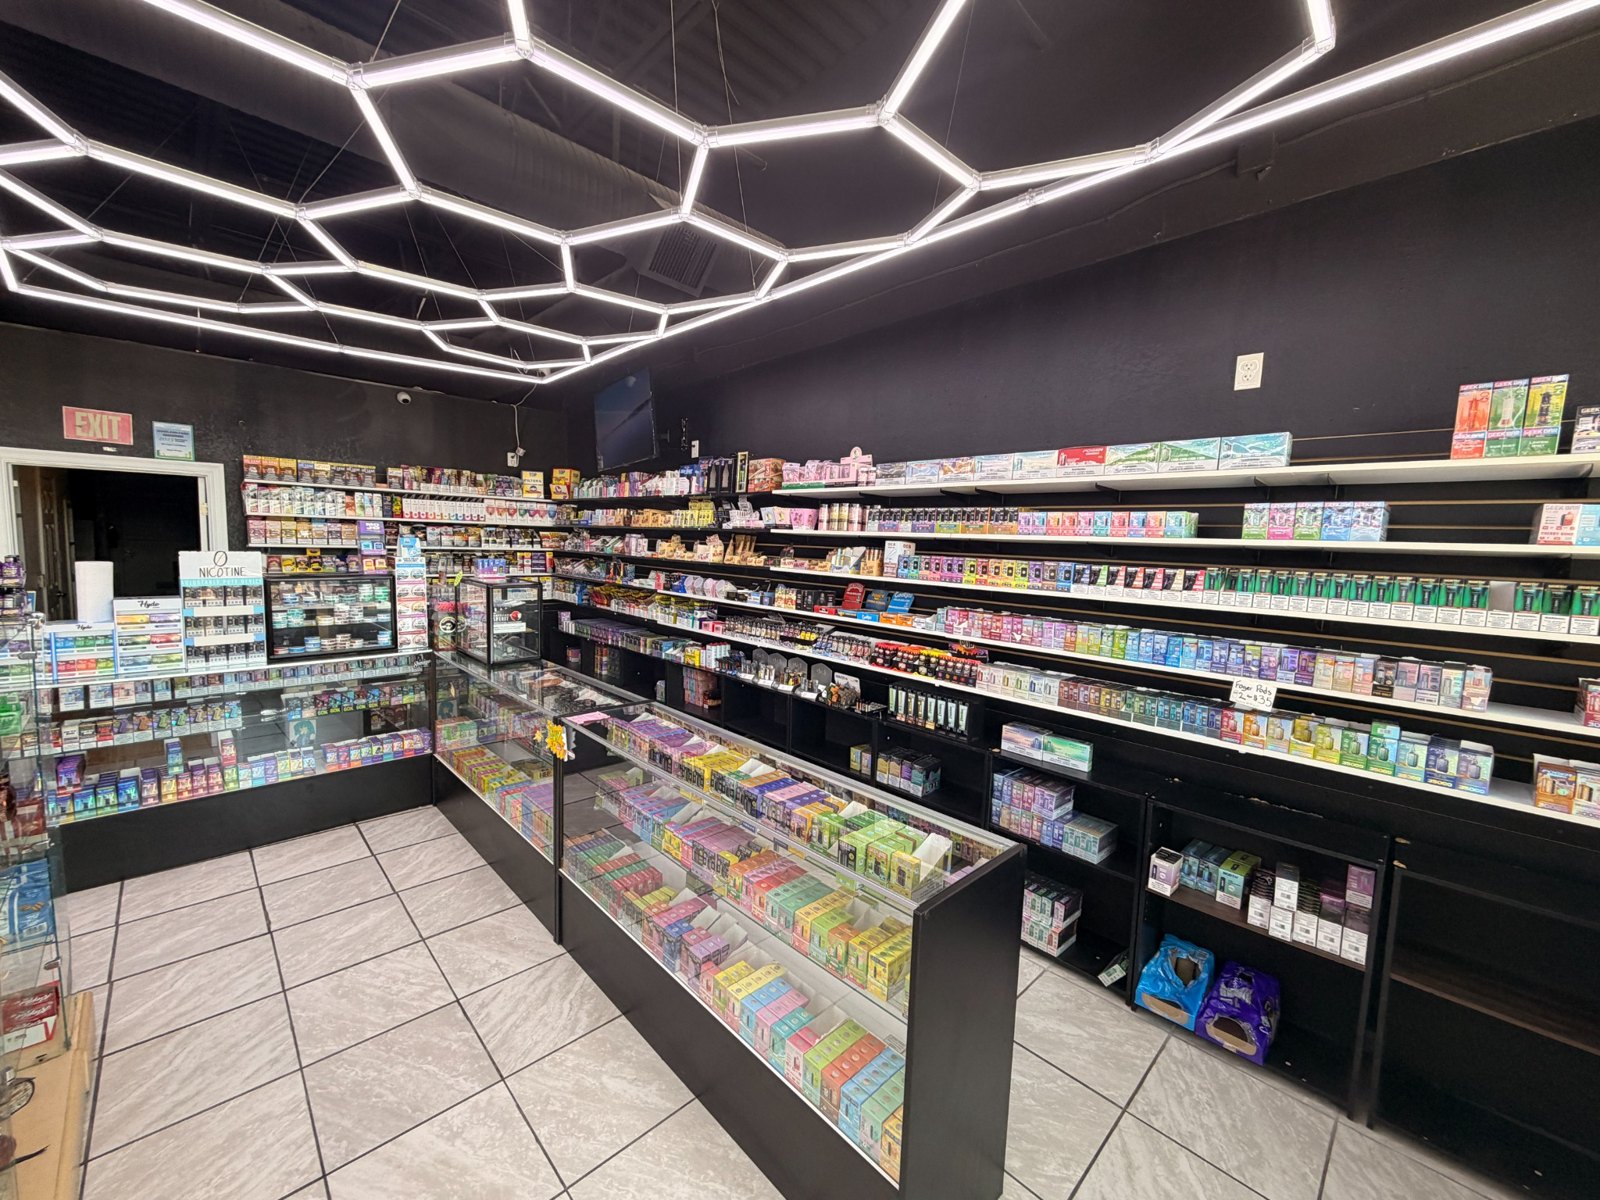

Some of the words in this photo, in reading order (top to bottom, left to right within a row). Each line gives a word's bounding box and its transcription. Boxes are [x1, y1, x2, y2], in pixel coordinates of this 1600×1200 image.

[75, 411, 121, 440] EXIT
[199, 566, 247, 578] NICOTINE
[1256, 684, 1272, 696] Pods
